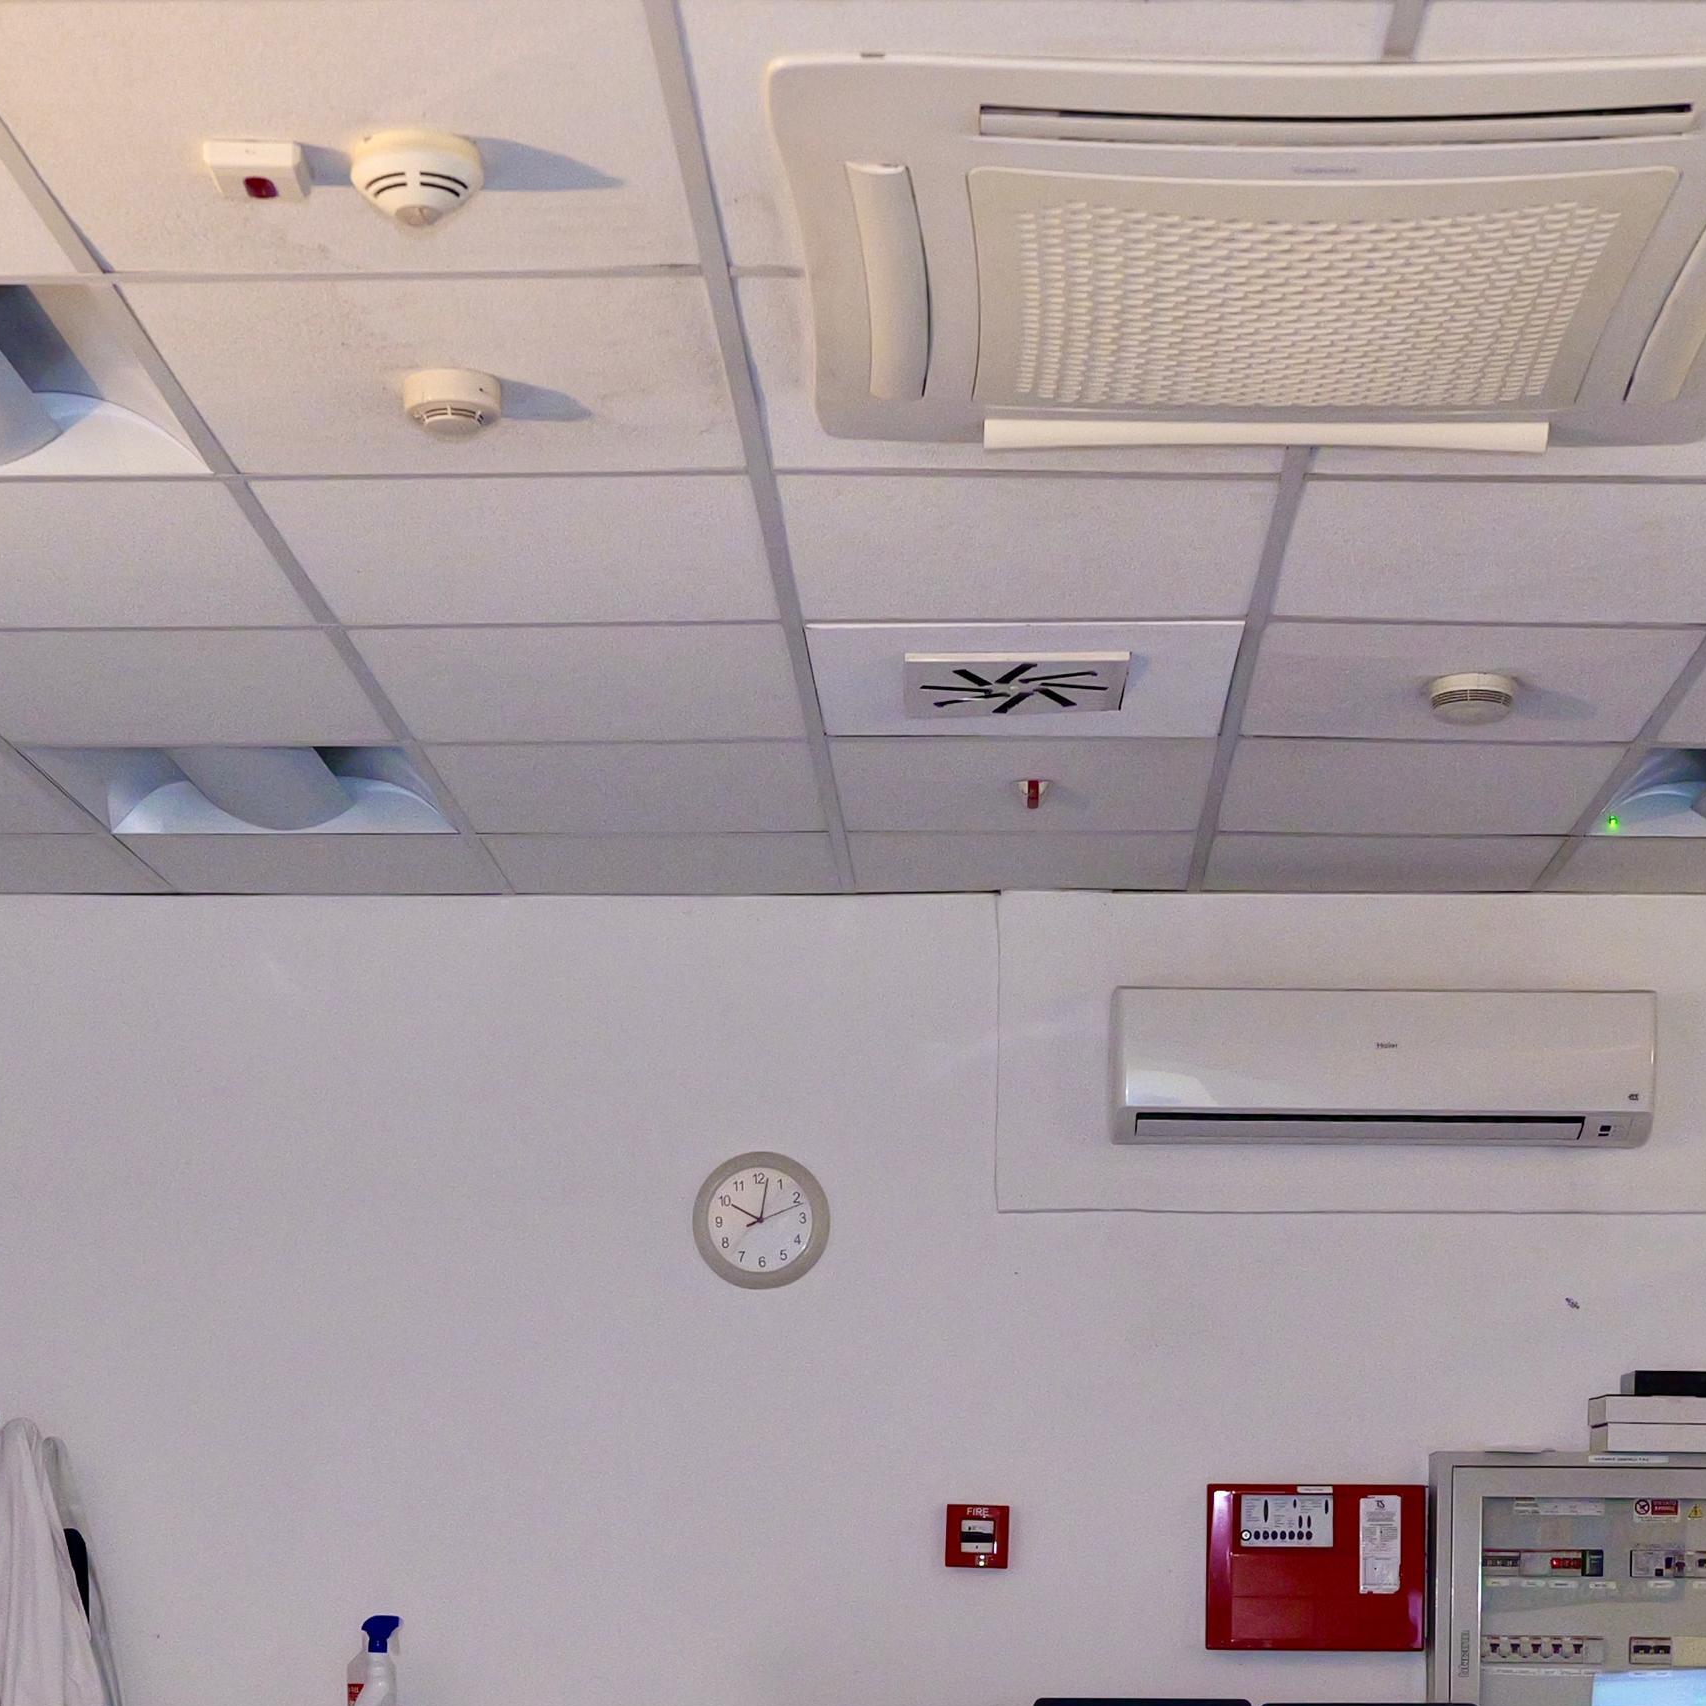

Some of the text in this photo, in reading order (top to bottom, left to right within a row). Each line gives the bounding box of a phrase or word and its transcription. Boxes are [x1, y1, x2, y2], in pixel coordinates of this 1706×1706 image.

[753, 1172, 765, 1184] 12
[733, 1180, 744, 1191] 11
[777, 1179, 783, 1190] 1
[719, 1194, 731, 1207] 10
[793, 1191, 801, 1204] 2
[715, 1216, 723, 1228] 9
[799, 1212, 807, 1224] 3
[721, 1237, 729, 1249] 8
[794, 1234, 801, 1245] 4
[738, 1250, 746, 1263] 7
[780, 1249, 788, 1261] 5
[758, 1256, 766, 1268] 6
[966, 1507, 989, 1516] FIRE
